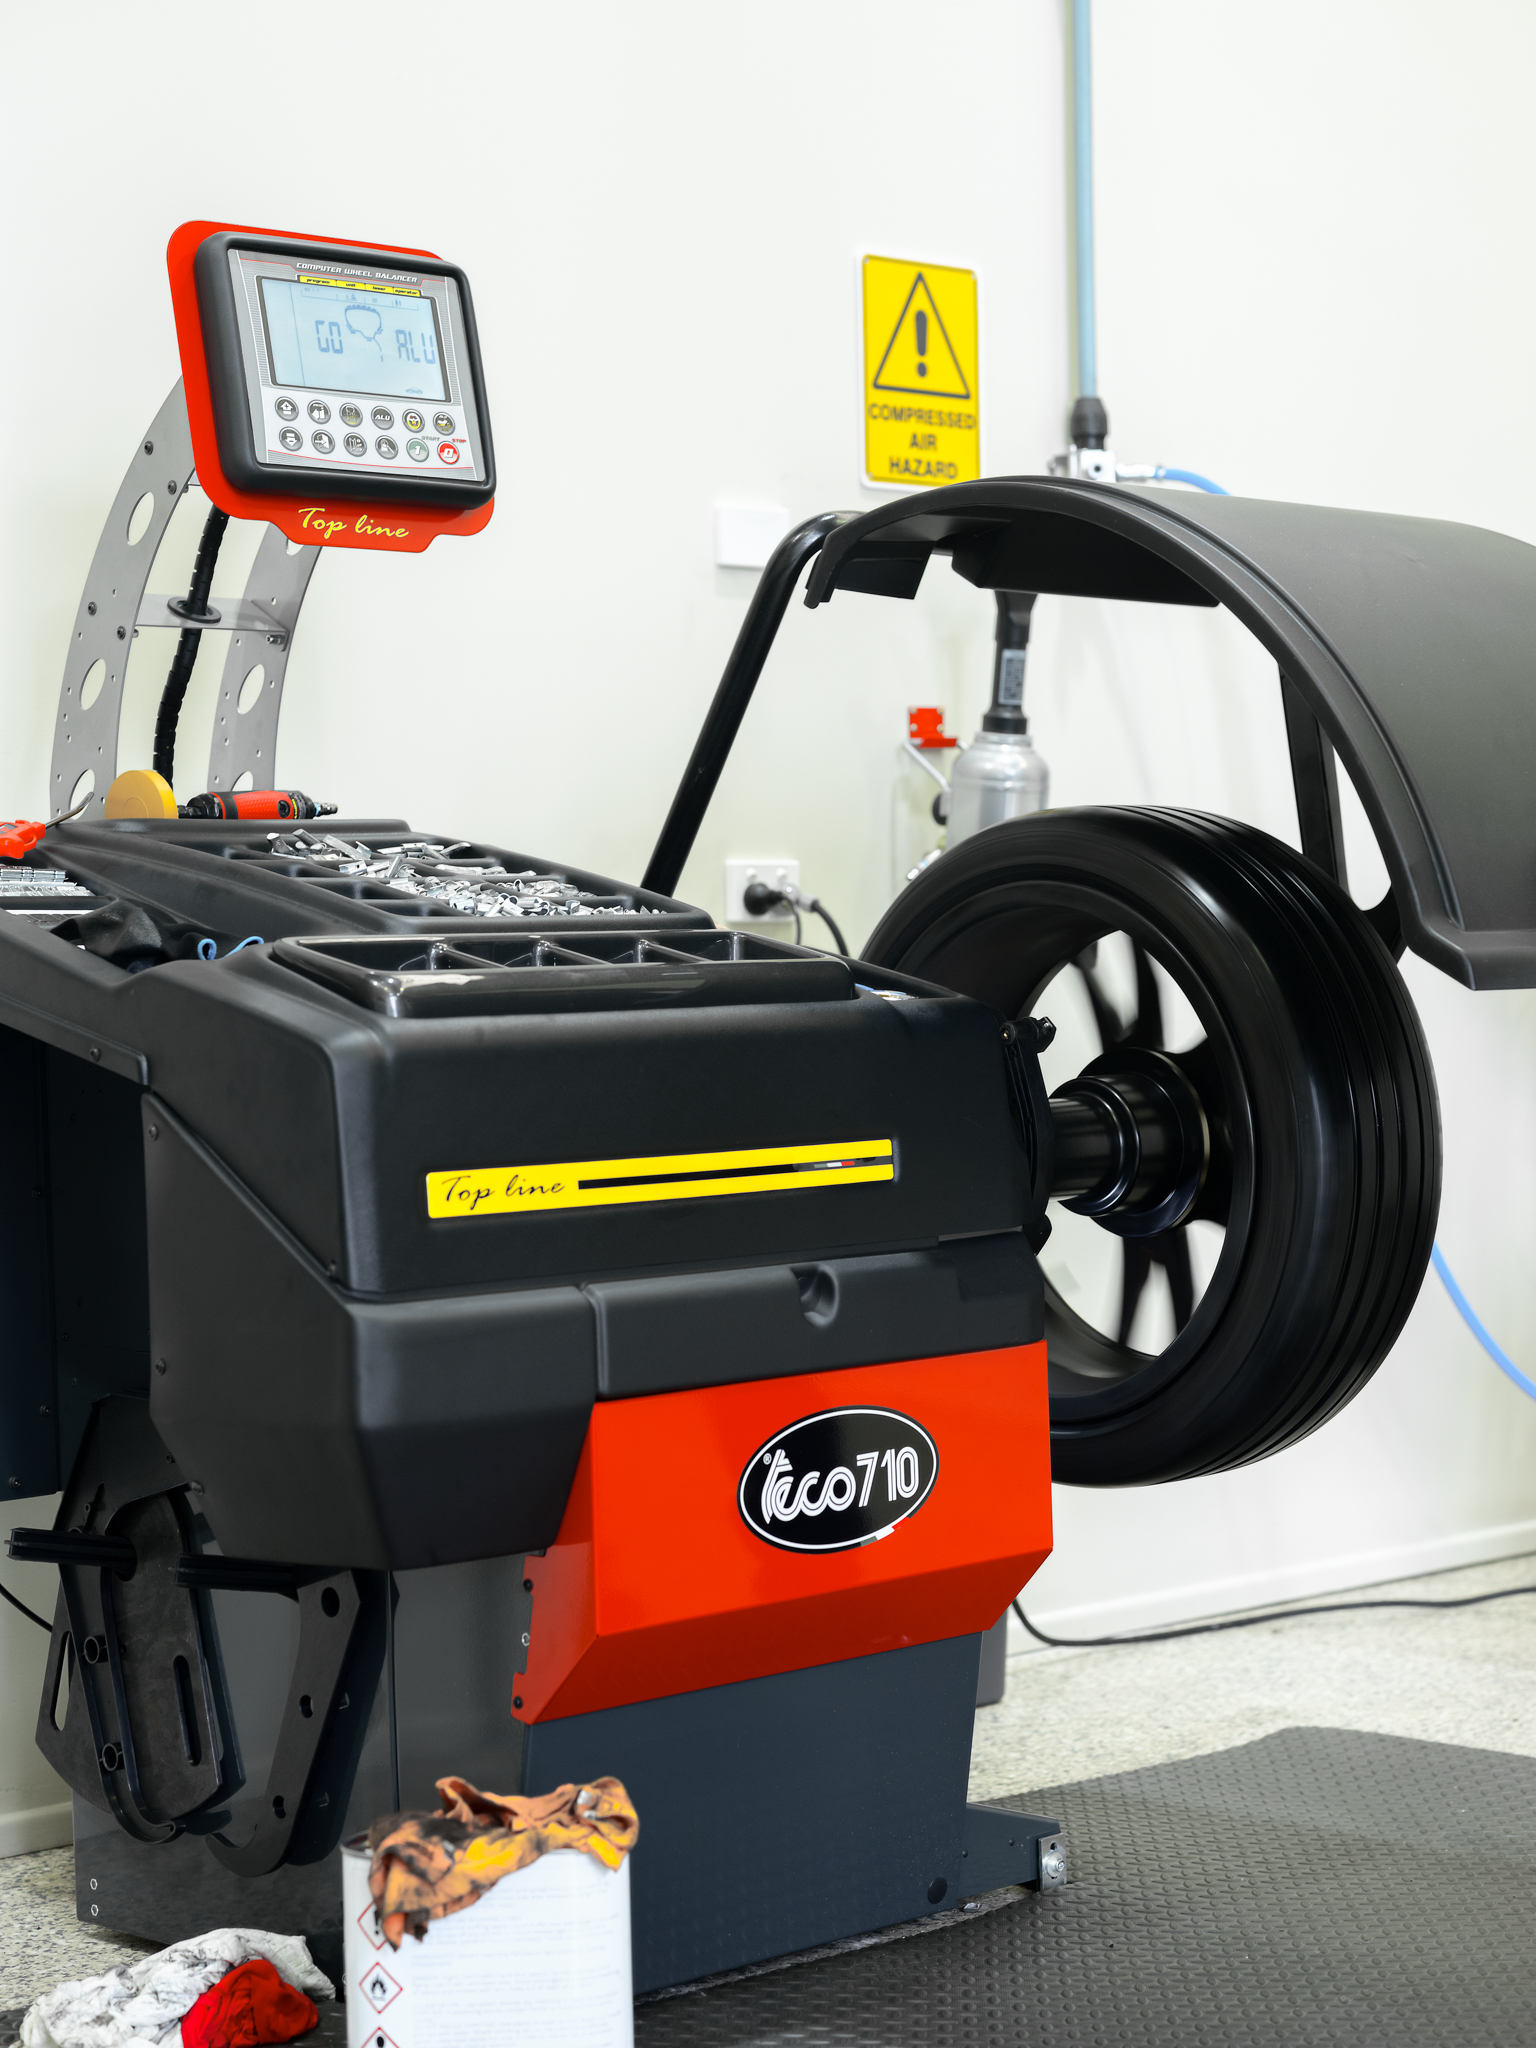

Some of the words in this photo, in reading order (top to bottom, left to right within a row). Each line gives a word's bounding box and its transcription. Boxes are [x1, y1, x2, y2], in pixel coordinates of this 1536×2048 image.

[296, 262, 342, 274] COMPUTER
[344, 267, 373, 277] WHEEL
[375, 272, 418, 283] BALANCER
[394, 288, 418, 296] operator
[374, 413, 391, 421] ALU
[868, 403, 976, 429] COMPRESSED
[414, 445, 420, 455] 1
[909, 433, 937, 451] AIR
[889, 457, 957, 479] HAZARD
[298, 507, 347, 540] Top
[355, 514, 409, 538] line
[441, 1175, 495, 1210] Top
[506, 1174, 565, 1197] line
